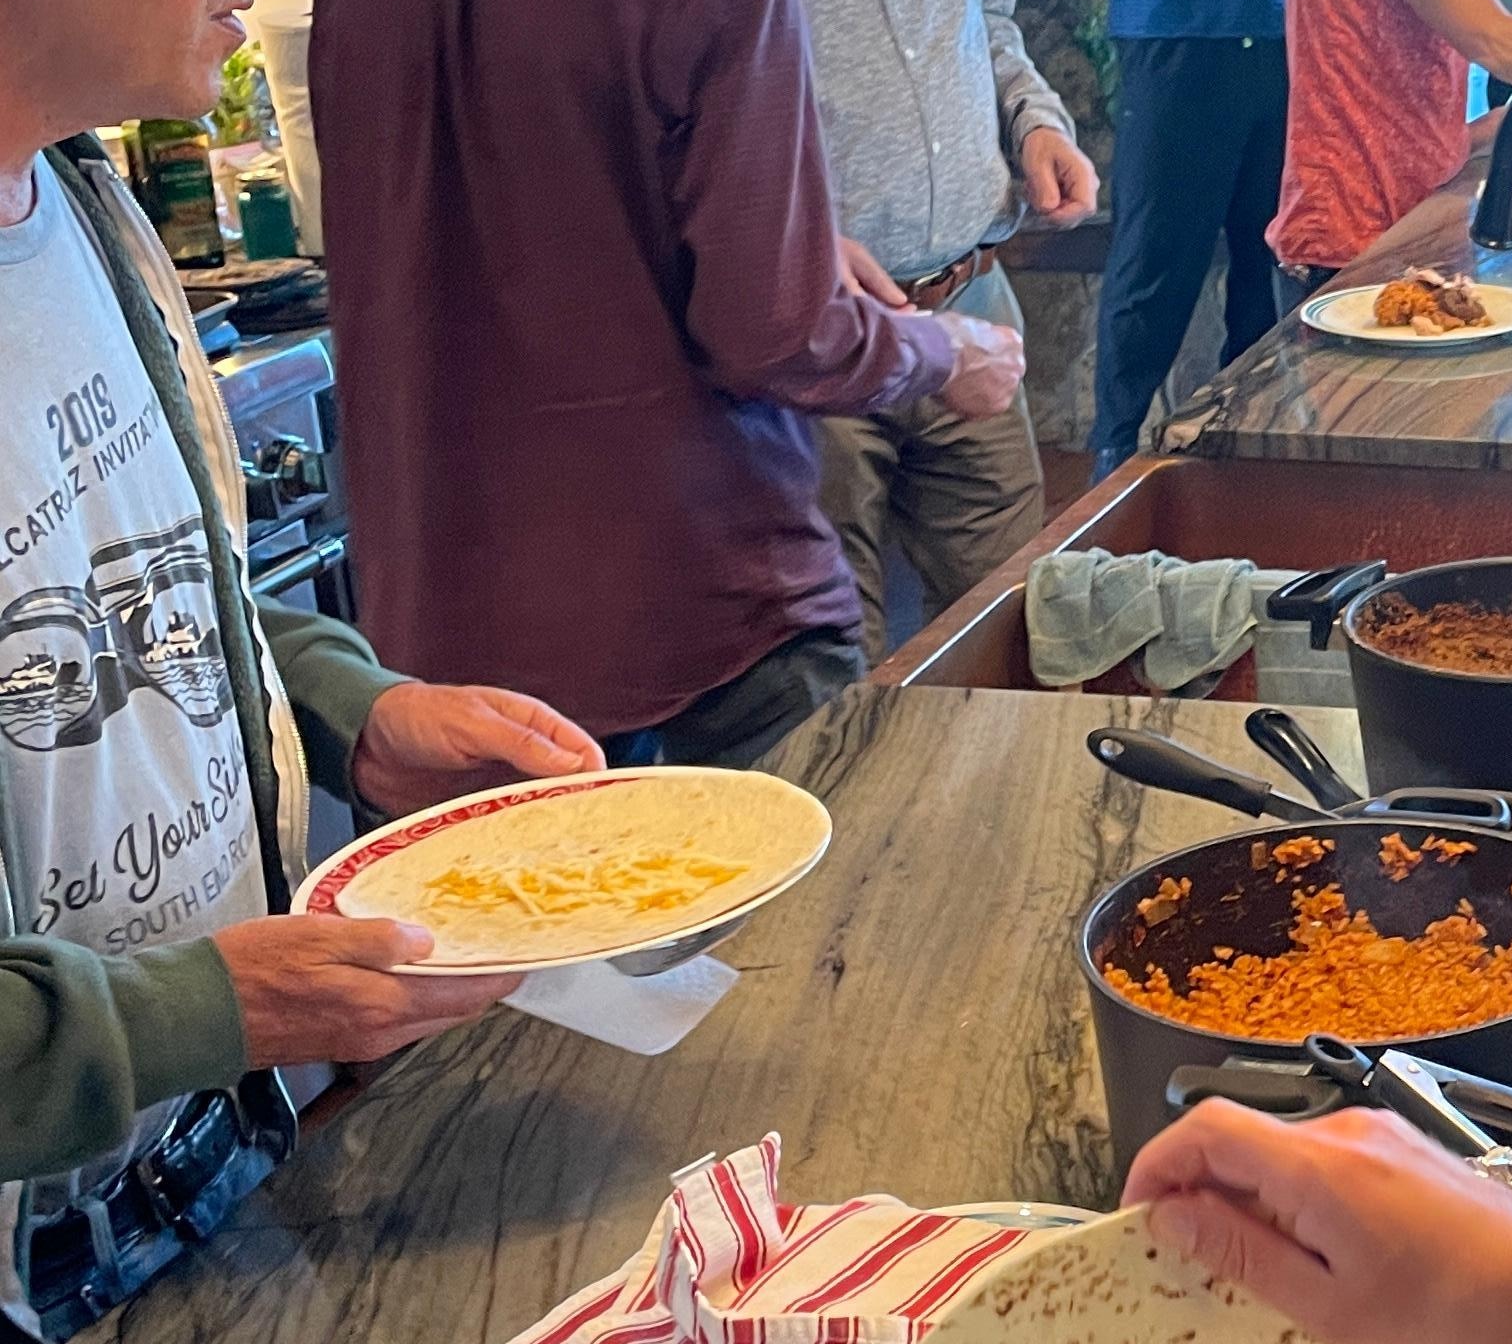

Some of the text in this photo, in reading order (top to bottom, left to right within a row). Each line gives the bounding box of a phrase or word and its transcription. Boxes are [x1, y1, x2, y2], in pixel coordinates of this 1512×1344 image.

[47, 372, 117, 462] 2019
[31, 859, 107, 936] Set
[113, 799, 212, 905] Your
[105, 884, 201, 955] SOUTH
